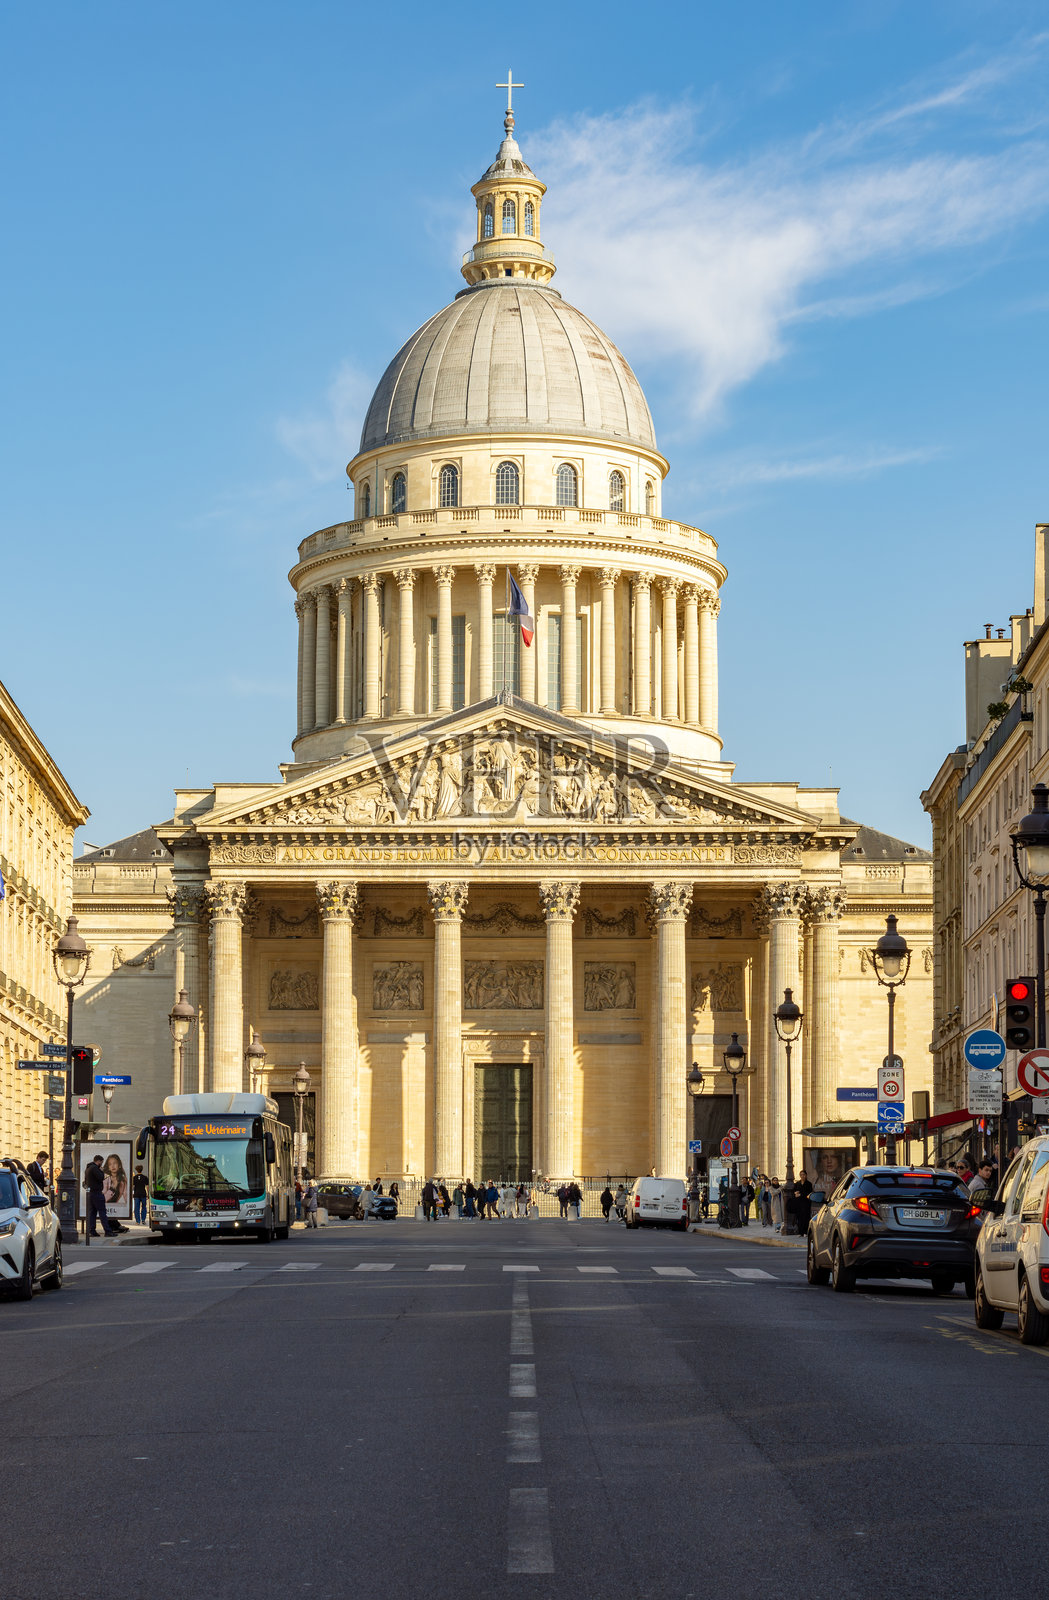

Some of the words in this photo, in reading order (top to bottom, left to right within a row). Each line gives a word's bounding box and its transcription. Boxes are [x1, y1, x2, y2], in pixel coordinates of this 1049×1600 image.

[283, 847, 318, 861] AUX
[323, 847, 393, 861] GRANDS
[161, 1126, 175, 1136] 24
[184, 1124, 204, 1135] Ecole
[206, 1124, 246, 1134] Vétérinaire
